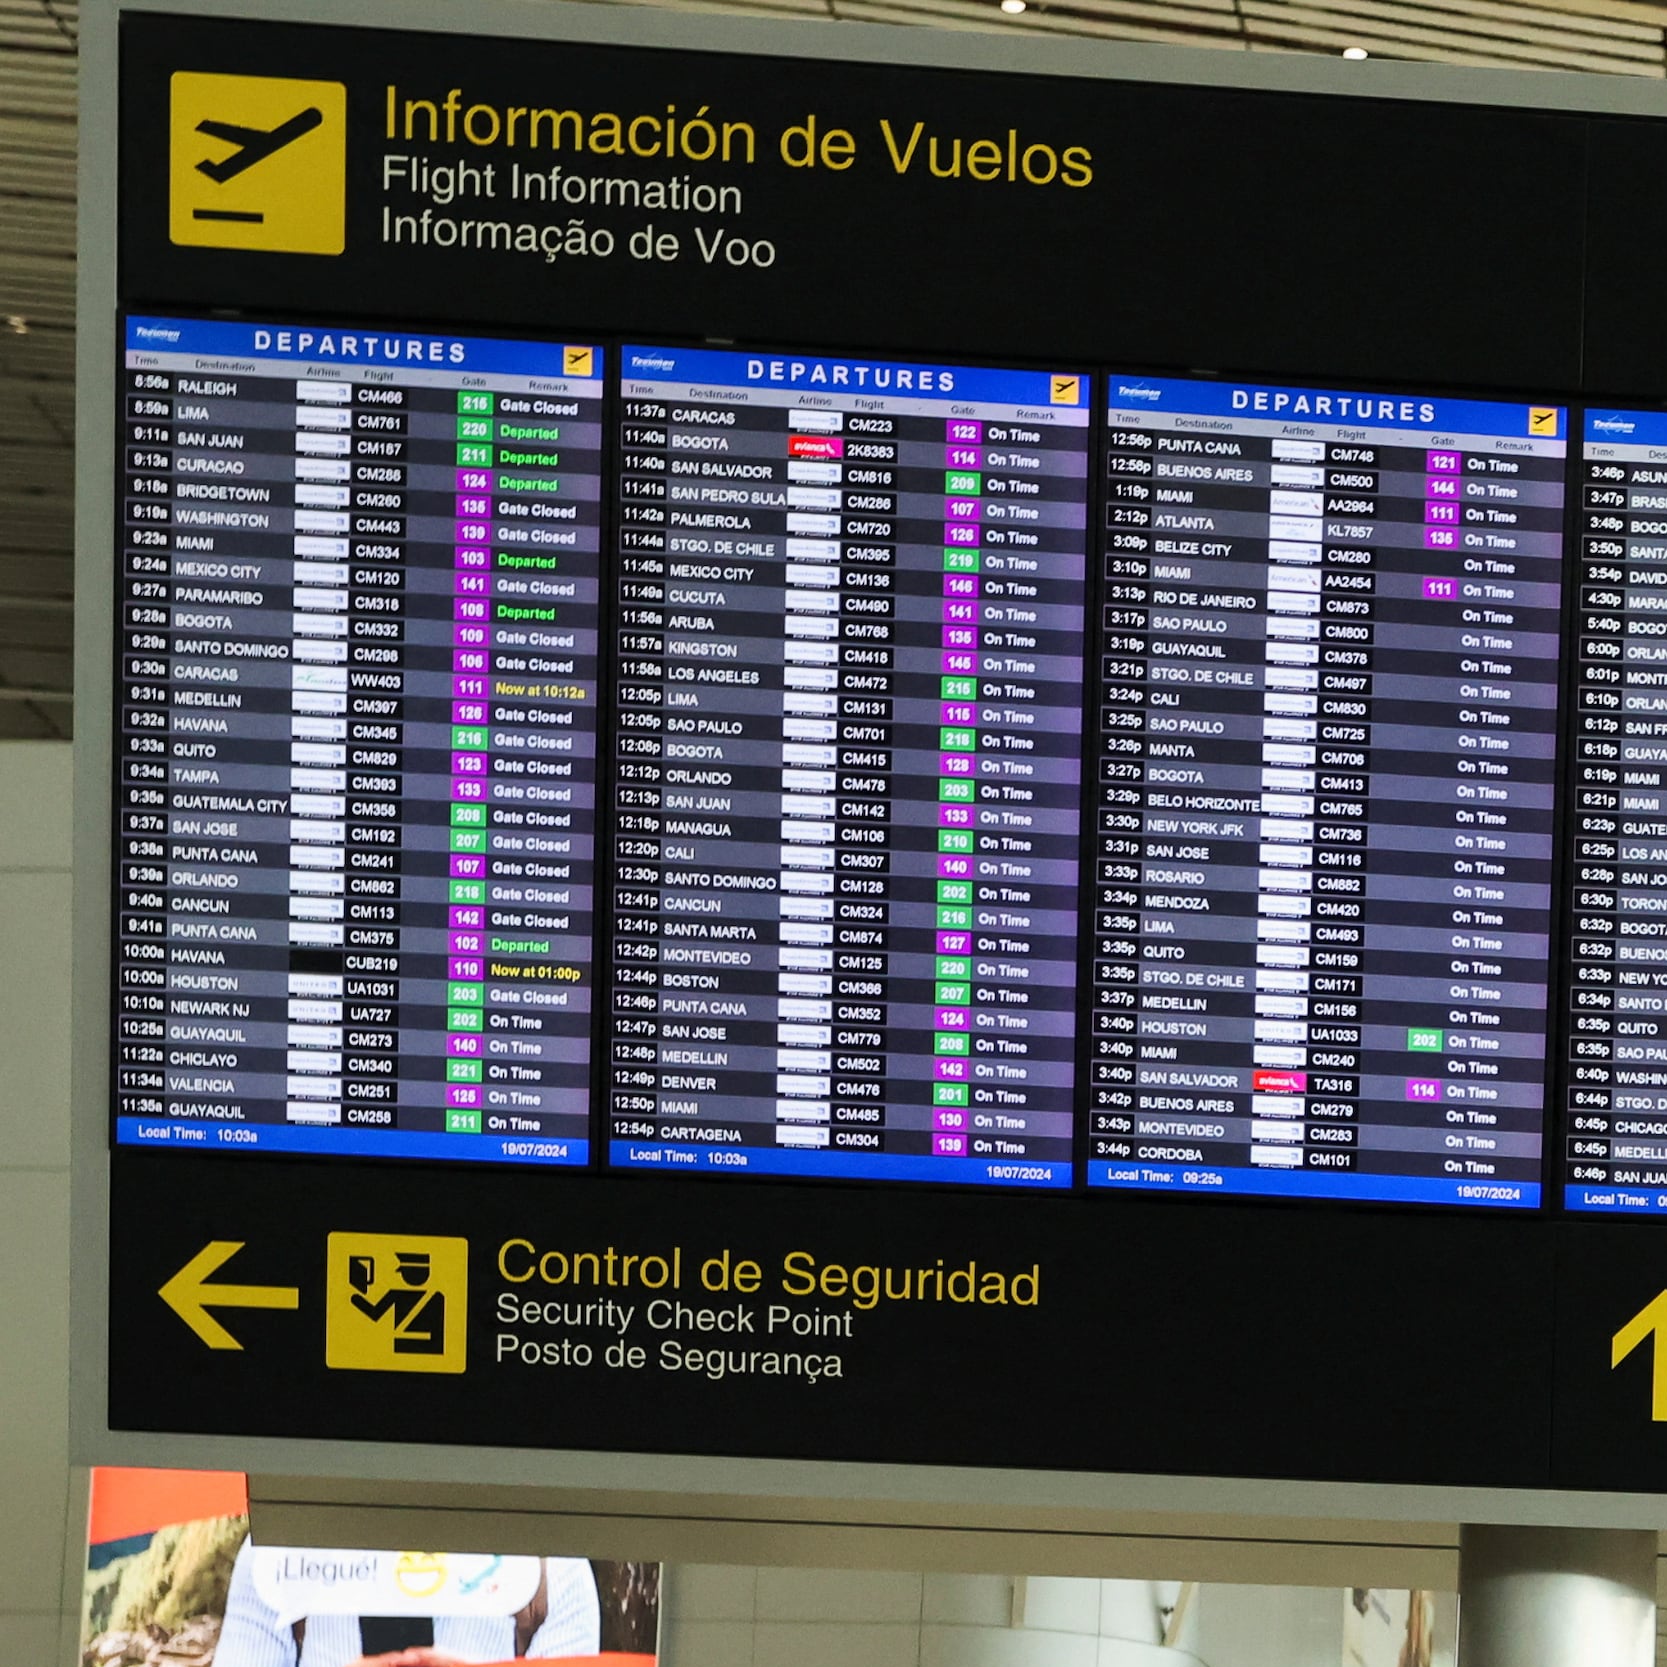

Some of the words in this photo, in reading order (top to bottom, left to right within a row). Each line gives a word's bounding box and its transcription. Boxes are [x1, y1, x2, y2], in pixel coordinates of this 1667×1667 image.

[384, 85, 755, 164] Información
[780, 115, 855, 171] de
[880, 119, 1094, 187] Vuelos
[383, 156, 497, 203] Flight
[512, 163, 741, 213] Information
[383, 207, 614, 262] Informação
[630, 224, 679, 260] de
[695, 226, 776, 267] Voo
[254, 330, 466, 363] DEPARTURES
[748, 359, 955, 392] DEPARTURES
[178, 407, 209, 421] LIMA
[501, 424, 558, 440] Departed
[626, 404, 665, 418] 11:37a
[672, 410, 735, 425] CARACAS
[849, 418, 892, 433] CM223
[953, 426, 976, 439] 122
[988, 428, 1007, 442] On
[1009, 430, 1040, 443] Time
[1232, 390, 1435, 422] DEPARTURES
[1158, 438, 1201, 454] PUNTA
[1203, 441, 1241, 455] CANA
[1331, 448, 1374, 463] CM748
[1433, 457, 1455, 469] 121
[1467, 459, 1486, 471] On
[1488, 460, 1518, 473] Time
[1591, 466, 1625, 482] 3:46p
[498, 1239, 680, 1289] Control
[702, 1250, 762, 1293] de
[783, 1252, 1039, 1310] Seguridad
[497, 1293, 634, 1335] Security
[647, 1299, 755, 1334] Check
[769, 1306, 853, 1338] Point
[497, 1334, 592, 1367] Posto
[605, 1339, 646, 1369] de
[659, 1341, 843, 1385] Segurança
[276, 1556, 378, 1587] ¡Llegué!
